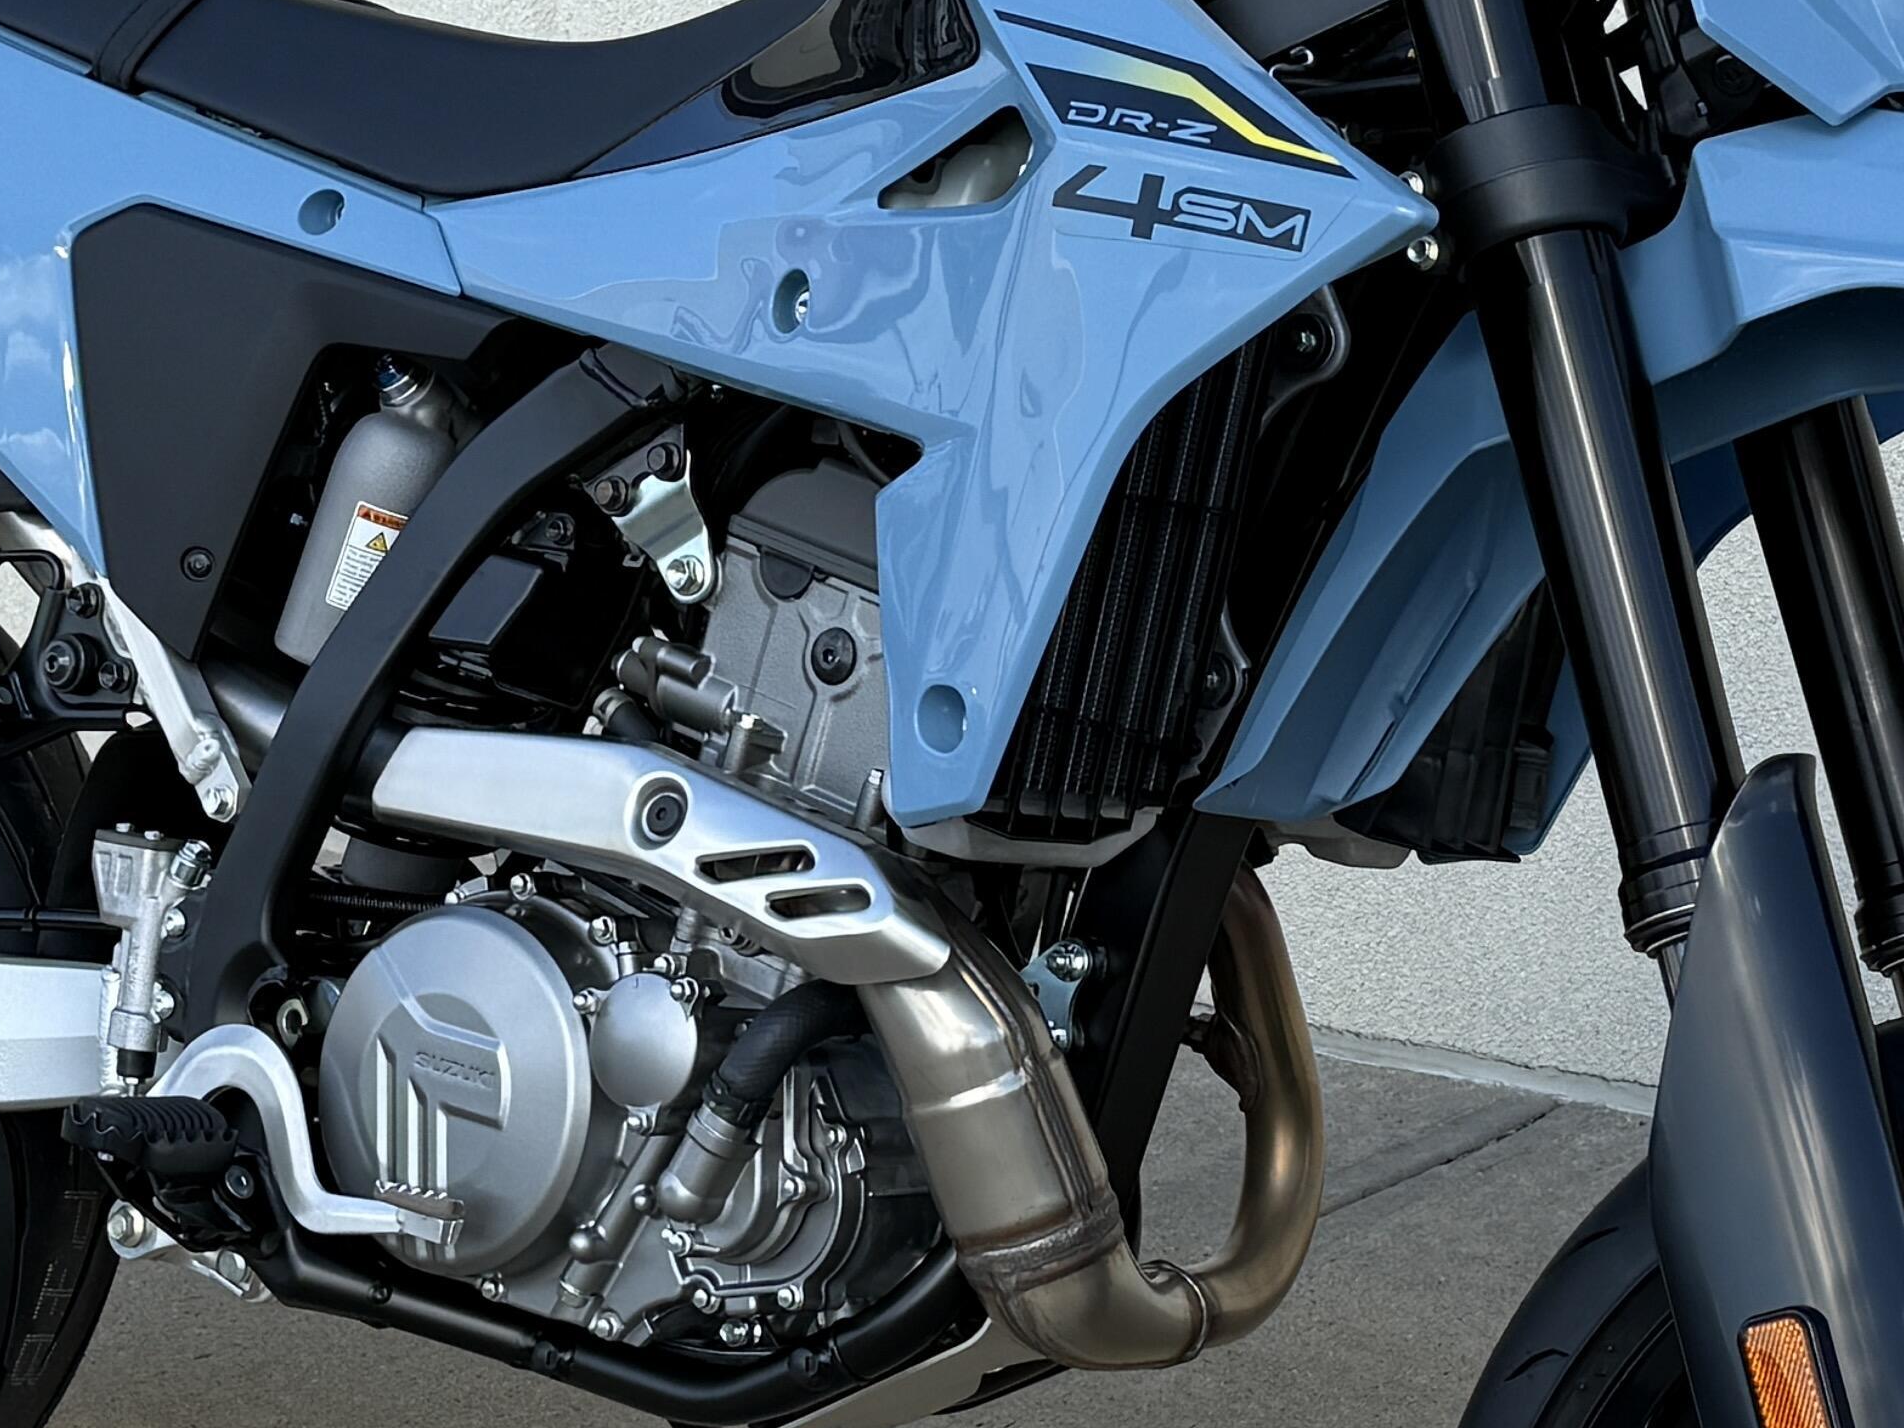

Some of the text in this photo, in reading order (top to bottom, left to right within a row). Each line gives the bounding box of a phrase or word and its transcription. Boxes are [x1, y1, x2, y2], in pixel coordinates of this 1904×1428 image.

[1065, 100, 1218, 146] DR-Z
[1051, 164, 1312, 253] 4SM
[413, 1051, 496, 1087] SUZUKI
